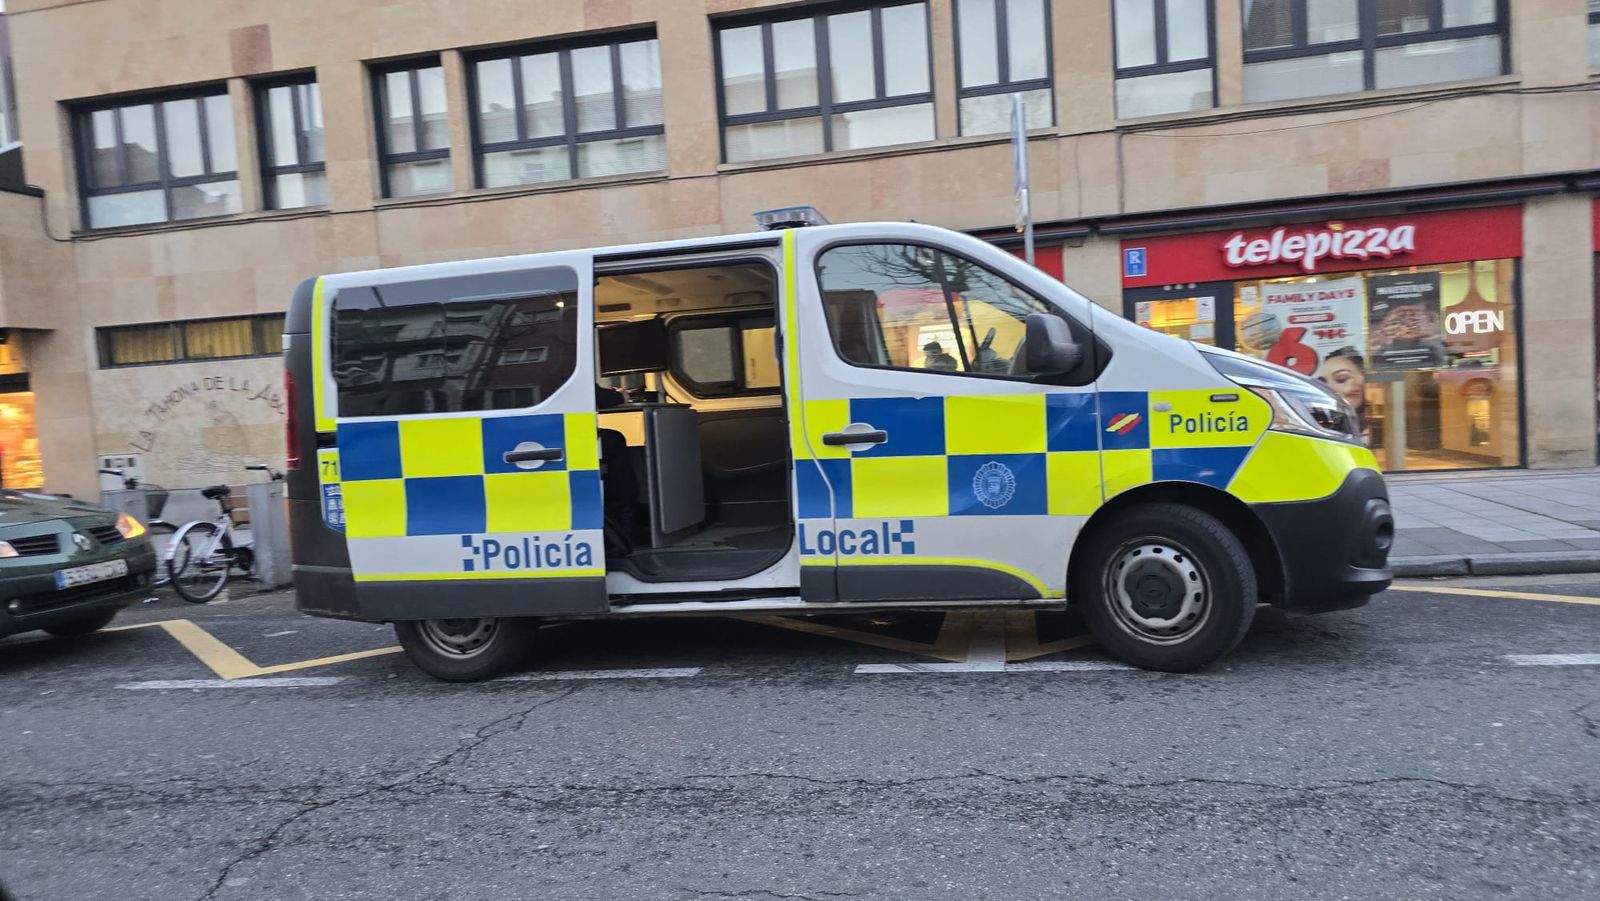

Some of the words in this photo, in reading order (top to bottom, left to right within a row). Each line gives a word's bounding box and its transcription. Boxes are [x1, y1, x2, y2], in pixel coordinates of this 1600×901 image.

[1223, 221, 1416, 271] telepizza
[1267, 292, 1316, 304] FAMILY
[1318, 289, 1355, 301] DAYS
[1445, 310, 1505, 335] OPEN
[203, 376, 224, 391] DE
[1169, 410, 1250, 435] Policía
[798, 521, 891, 556] Local
[482, 534, 593, 570] Policía
